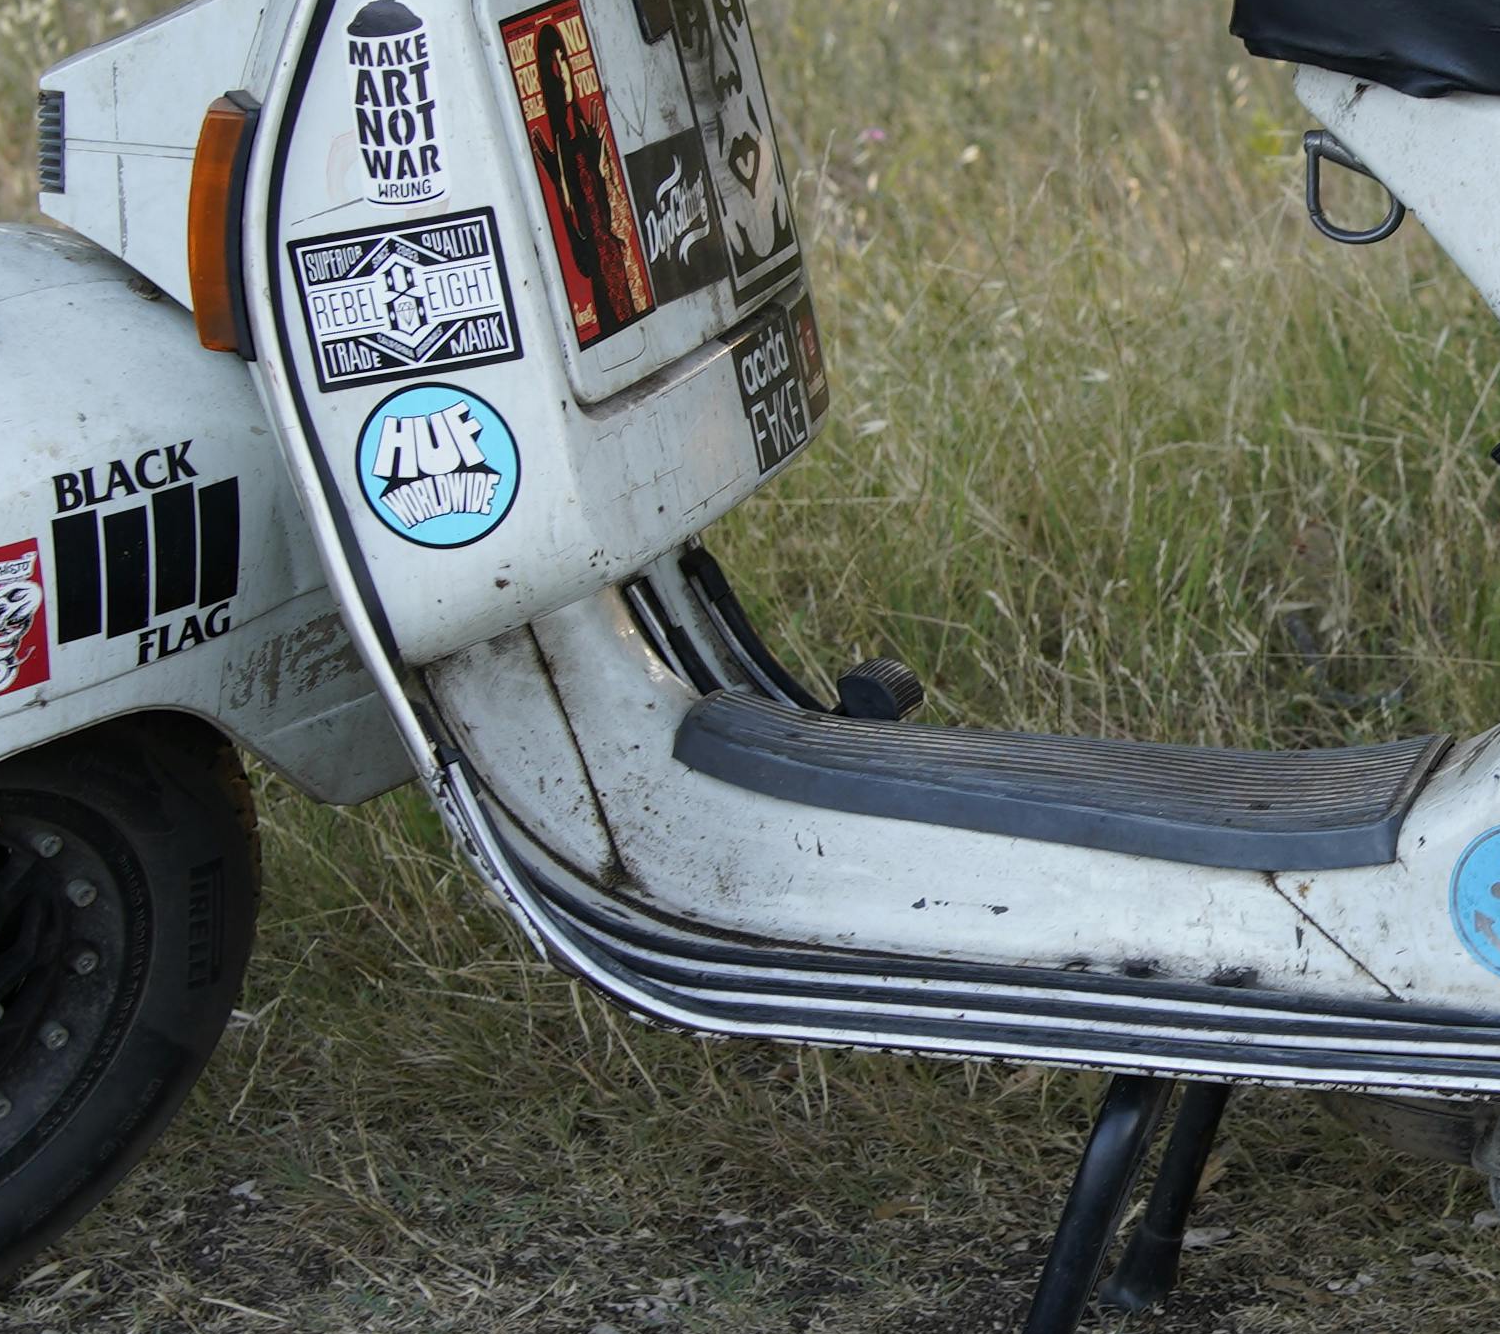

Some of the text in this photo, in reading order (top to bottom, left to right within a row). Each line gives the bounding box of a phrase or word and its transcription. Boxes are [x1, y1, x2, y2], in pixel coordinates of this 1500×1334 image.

[349, 33, 429, 67] MAKE
[355, 61, 430, 107] ART
[355, 100, 436, 146] NOT
[361, 144, 442, 180] WAR
[378, 179, 432, 199] WRUNG
[305, 224, 483, 282] SUPERIOR QUALITY
[312, 266, 496, 330] REBEL EIGHT
[325, 340, 382, 375] TRADE
[450, 316, 506, 355] MARK
[741, 326, 790, 395] acida
[372, 400, 490, 480] HUF
[52, 439, 199, 513] BLACK
[380, 470, 501, 531] WORLDWIDE
[138, 602, 232, 665] FLAG
